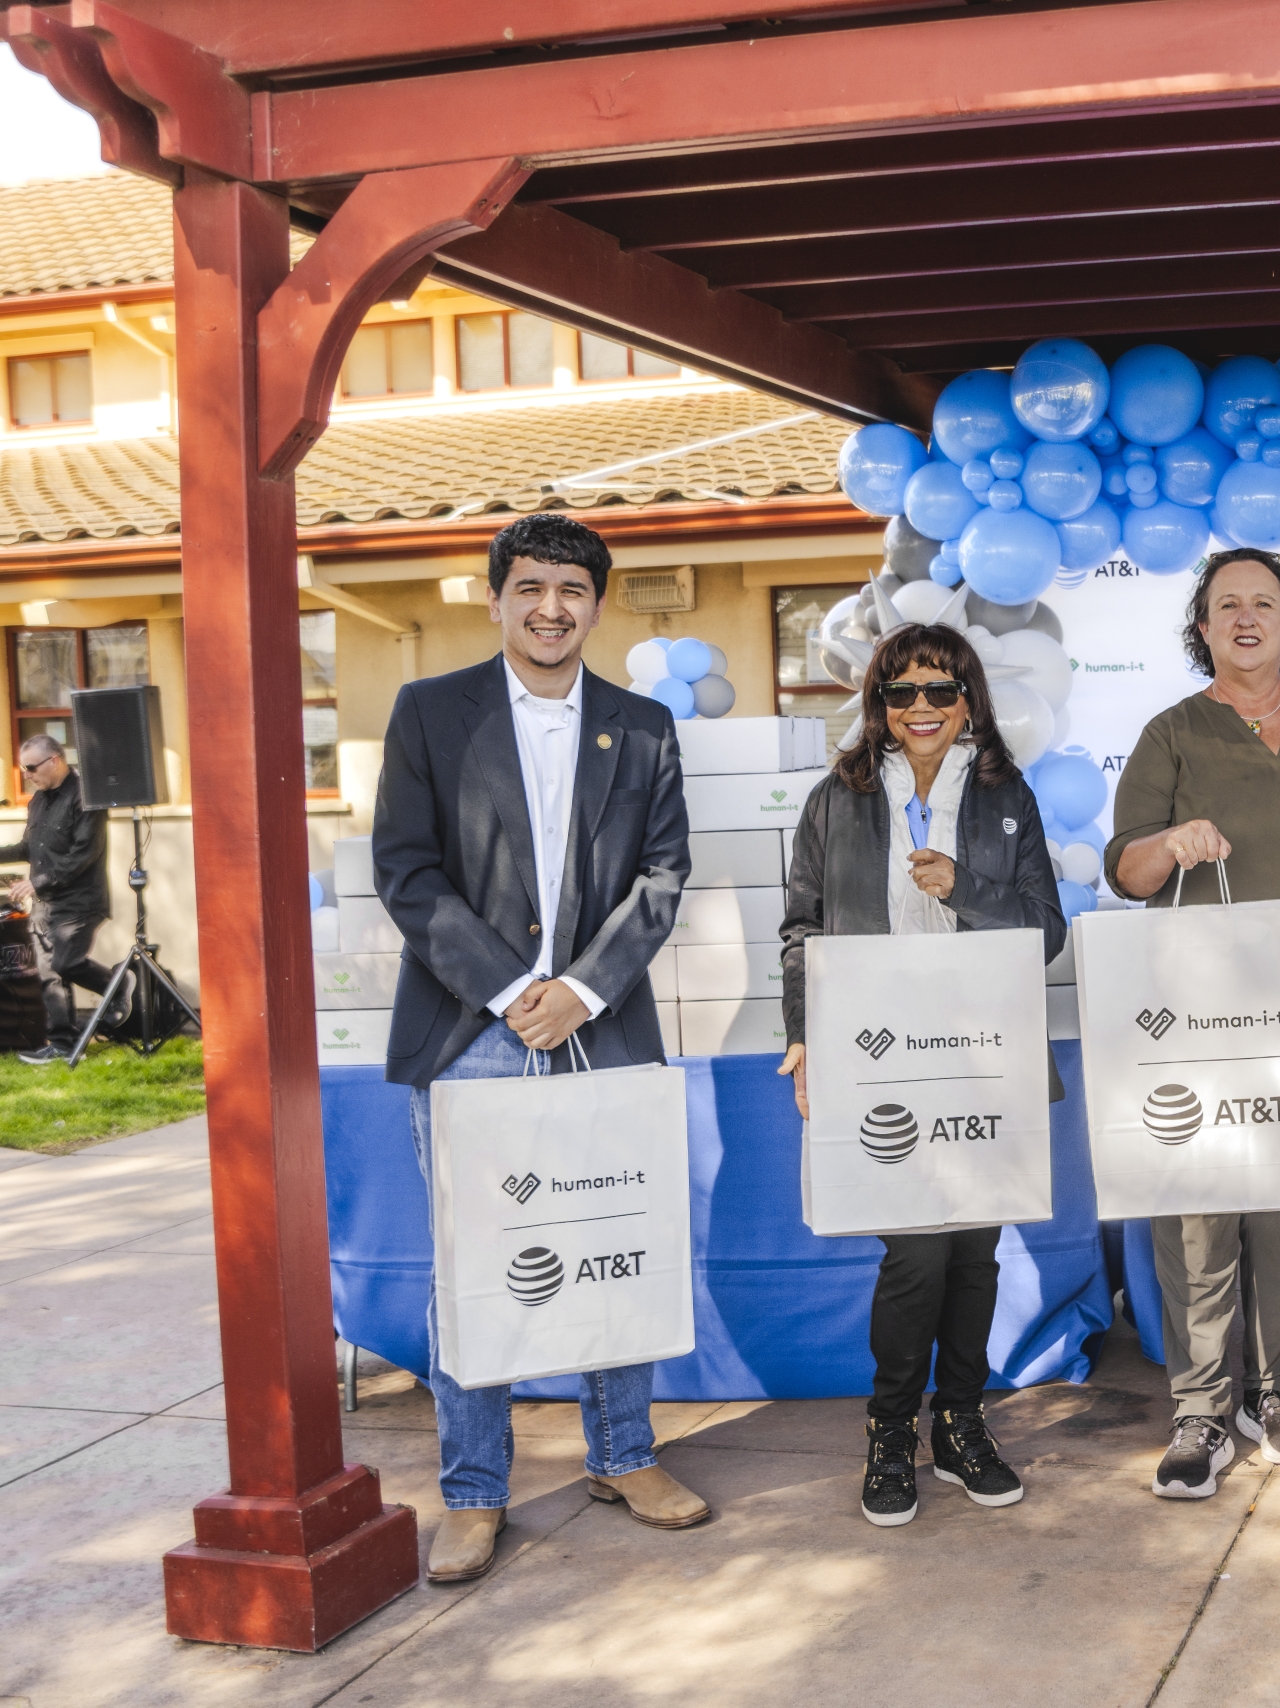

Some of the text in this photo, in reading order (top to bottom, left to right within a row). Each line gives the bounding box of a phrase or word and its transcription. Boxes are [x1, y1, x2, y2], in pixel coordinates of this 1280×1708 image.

[1085, 661, 1145, 672] human-i-t
[760, 804, 799, 812] human-i-t
[906, 1031, 1002, 1050] human-i-t
[929, 1115, 1003, 1144] AT&T
[551, 1171, 645, 1193] human-i-t
[575, 1250, 646, 1284] AT&T
